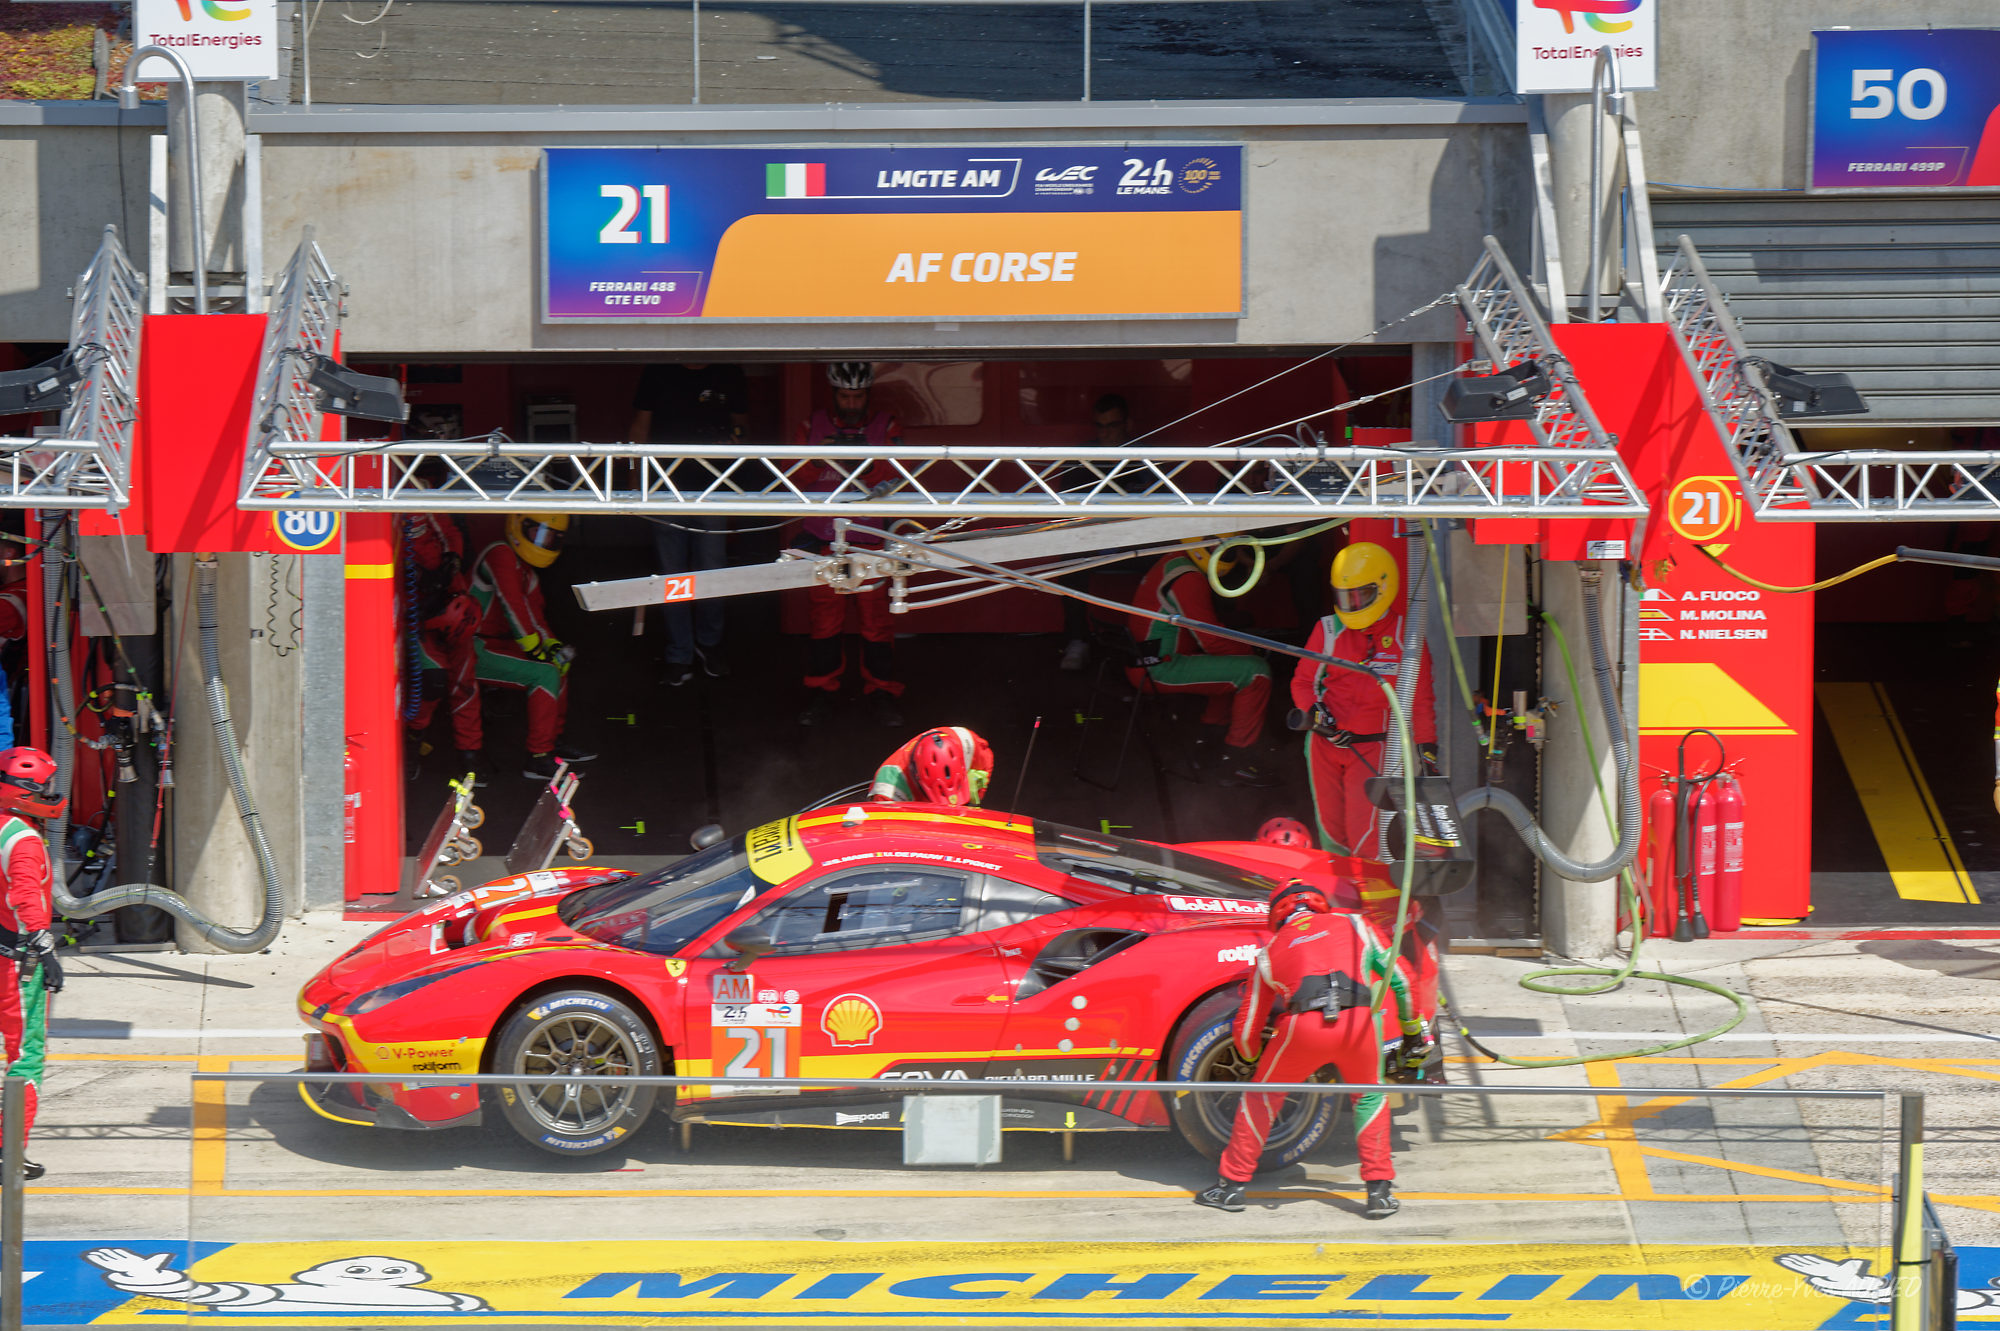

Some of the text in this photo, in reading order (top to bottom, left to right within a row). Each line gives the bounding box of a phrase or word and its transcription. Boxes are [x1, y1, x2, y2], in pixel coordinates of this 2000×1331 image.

[149, 33, 262, 49] TotalEnergies
[1532, 45, 1643, 60] TotalEneies
[1850, 67, 1948, 121] 50
[1118, 158, 1174, 186] 24h
[1848, 162, 1946, 172] FERRARI 499P
[876, 169, 1002, 188] LMGTE AM
[1116, 186, 1173, 195] LE MANS
[598, 184, 670, 244] 21
[885, 251, 1078, 283] AF CORSE
[589, 281, 677, 292] FERRARI 488
[604, 294, 661, 305] GTE EVO
[1680, 491, 1721, 525] 21
[283, 510, 329, 535] 80
[666, 578, 693, 600] 21
[717, 978, 751, 999] AM
[549, 996, 611, 1011] MICHELIN
[392, 1047, 455, 1060] V-Power
[724, 1027, 787, 1078] 21
[1179, 1022, 1232, 1079] MICHELIN
[859, 1111, 890, 1122] paoli
[544, 1135, 606, 1150] MICHELIN
[562, 1272, 1751, 1301] MICHELIN
